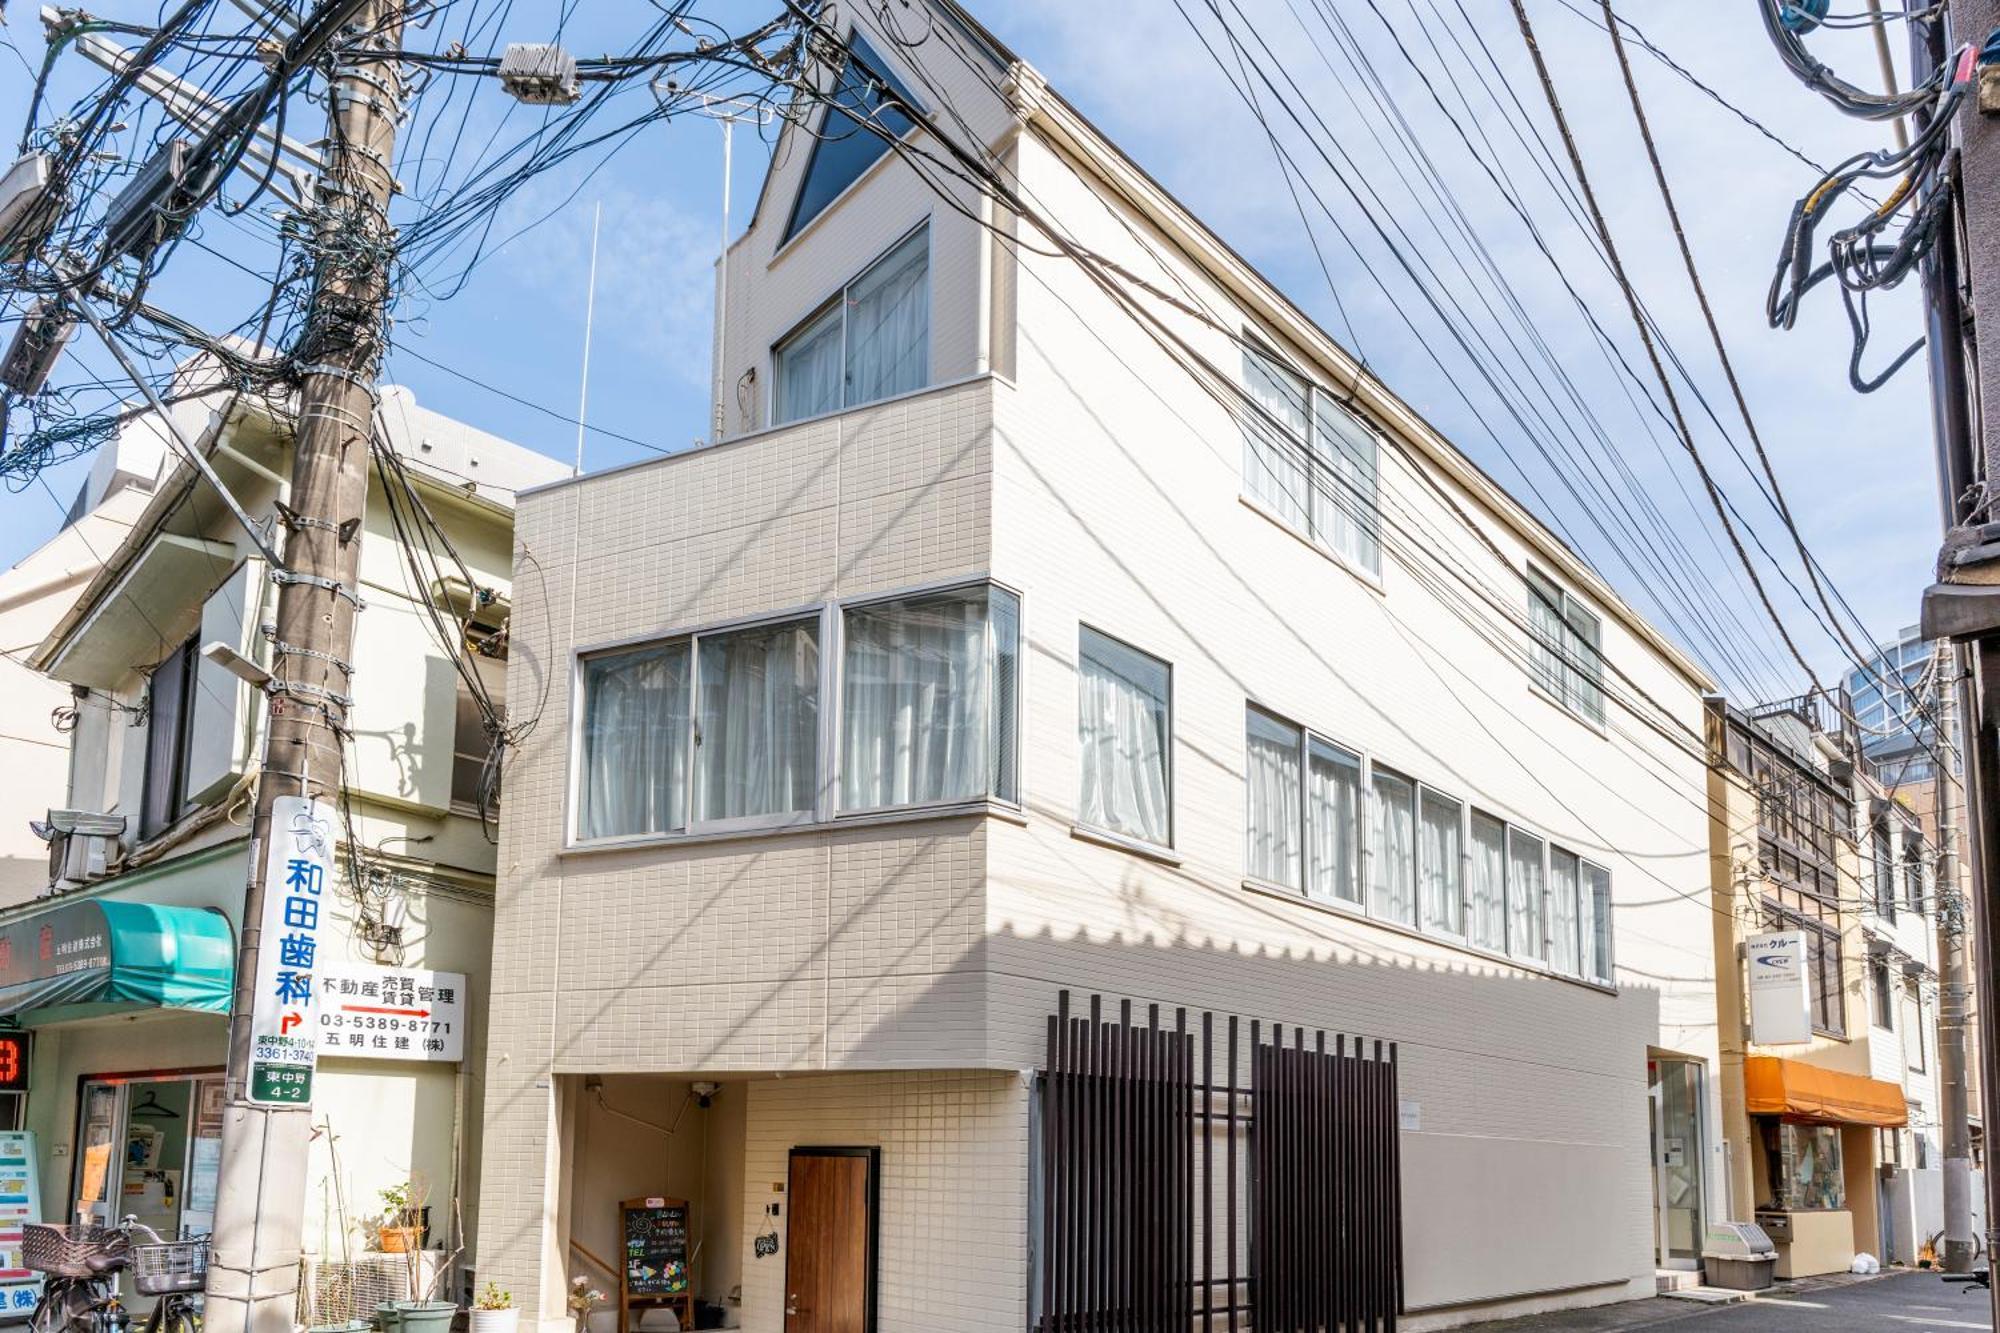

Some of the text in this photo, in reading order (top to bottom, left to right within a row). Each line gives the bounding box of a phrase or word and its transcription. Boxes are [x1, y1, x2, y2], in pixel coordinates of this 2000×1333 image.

[275, 859, 323, 1006] 和田歯科
[323, 976, 455, 1004] 不動産 売買 管理
[382, 991, 415, 1007] 賃貸
[320, 1013, 450, 1034] 03-5389-8771
[266, 1071, 305, 1084] 東中野
[271, 1086, 301, 1098] 4-2
[628, 1248, 645, 1257] TEL
